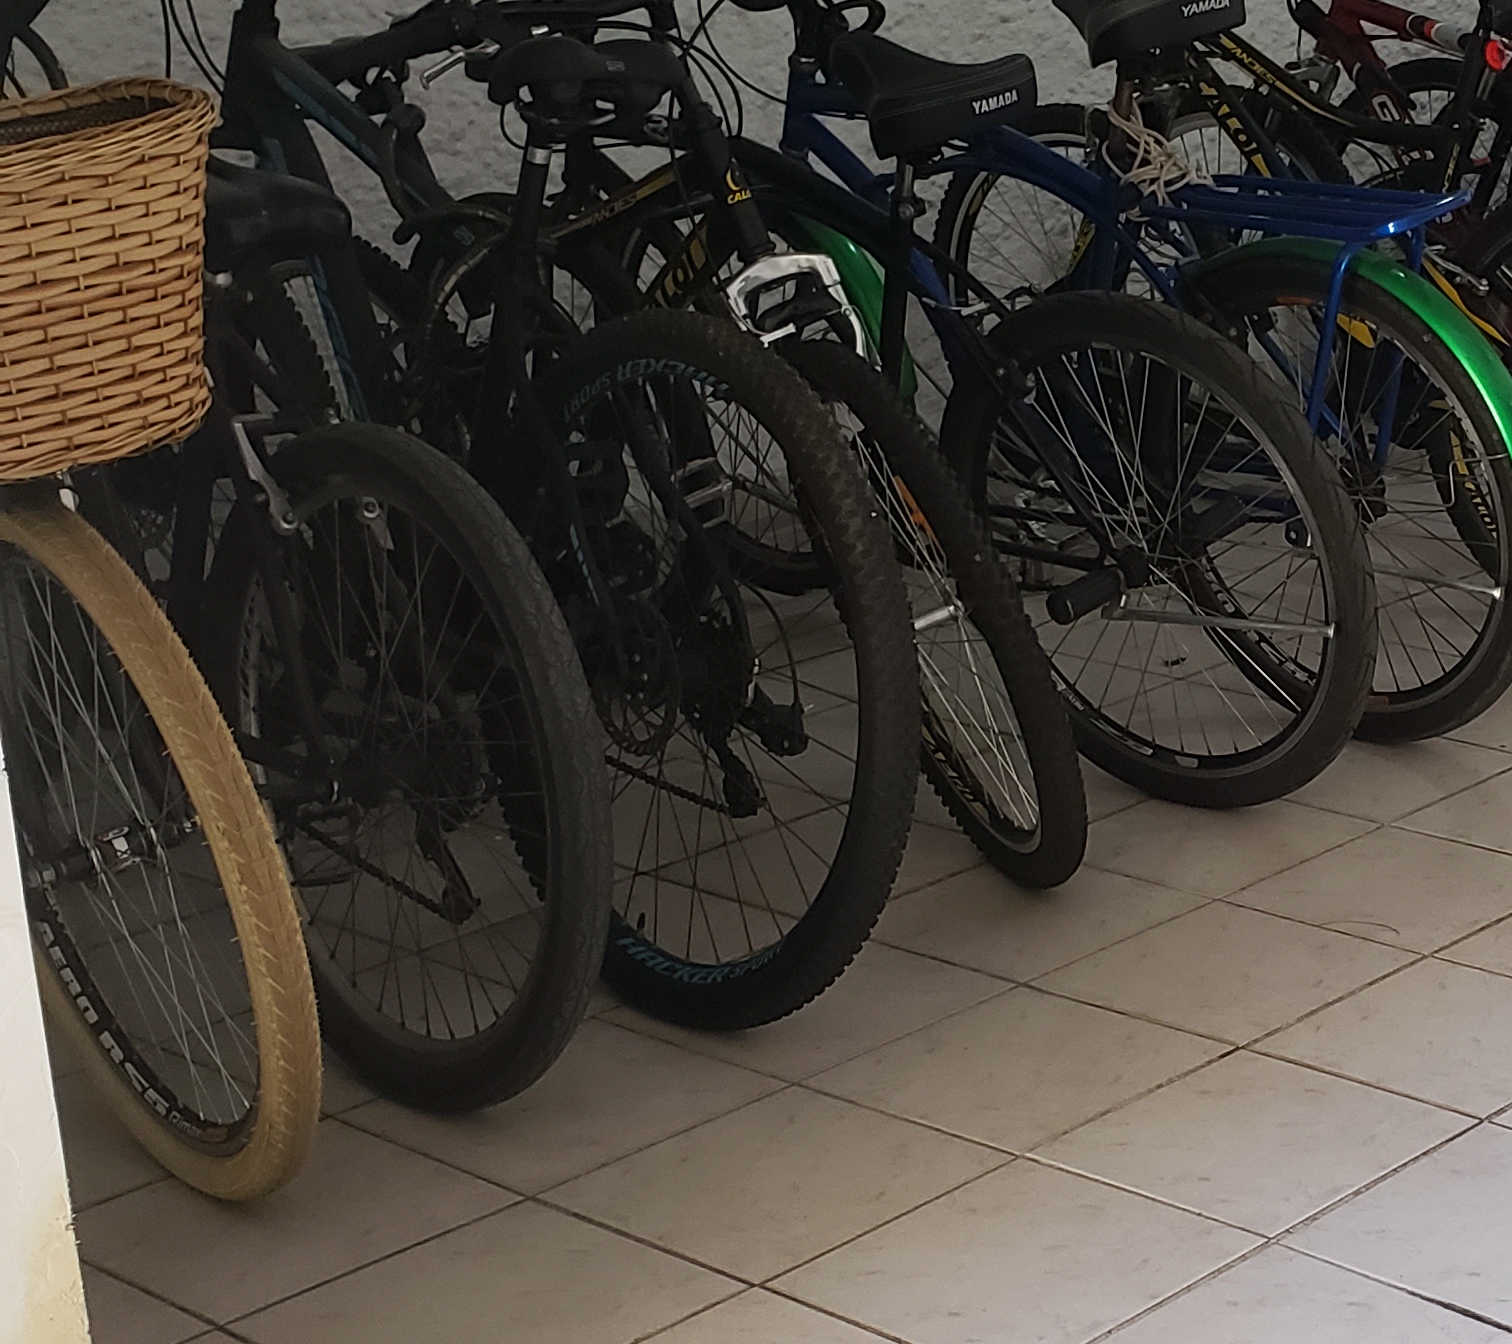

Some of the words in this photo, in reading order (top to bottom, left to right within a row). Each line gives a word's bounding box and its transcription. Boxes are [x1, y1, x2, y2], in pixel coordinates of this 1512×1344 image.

[1230, 47, 1275, 85] ANDES
[971, 88, 1019, 115] YAMADA
[615, 937, 731, 984] HACKER
